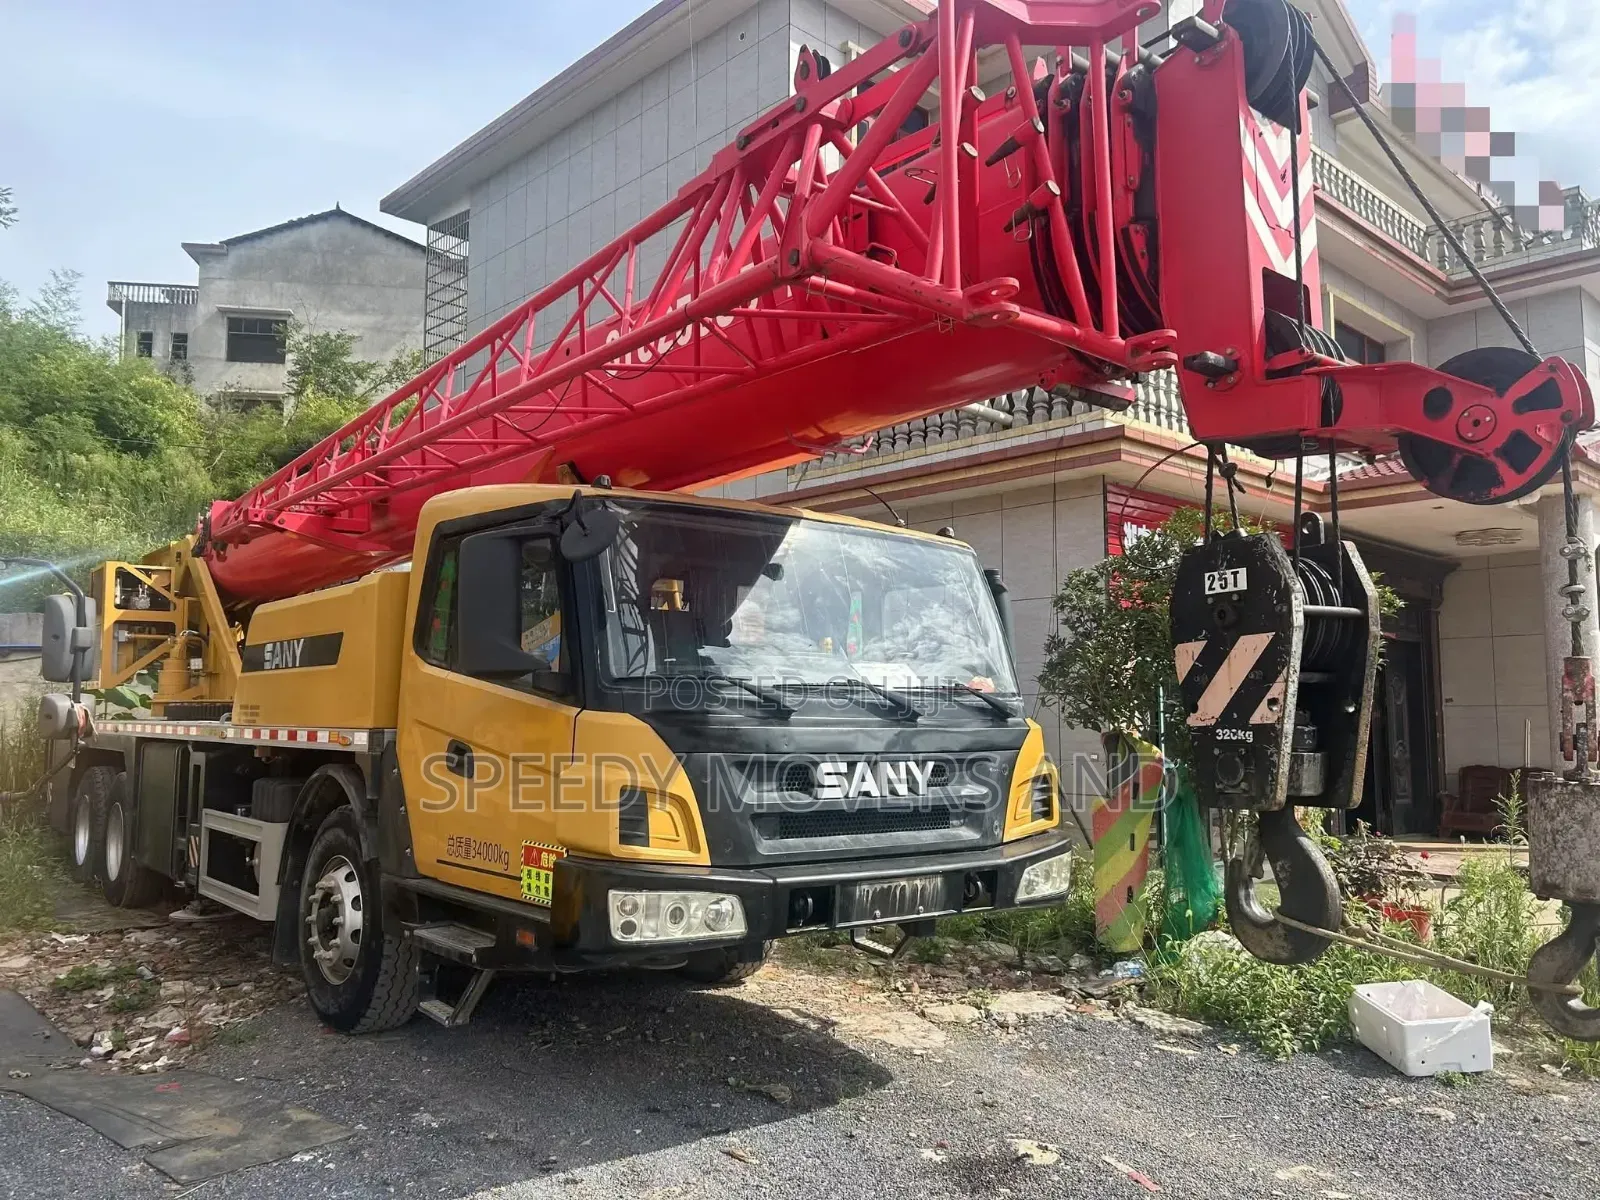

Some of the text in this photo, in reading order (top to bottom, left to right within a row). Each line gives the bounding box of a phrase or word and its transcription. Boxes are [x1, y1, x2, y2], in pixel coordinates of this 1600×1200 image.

[1207, 570, 1240, 592] 25T
[263, 638, 304, 670] SANY
[1215, 728, 1254, 744] 320kg
[816, 760, 935, 799] SANY
[446, 834, 510, 871] 总质量34000kg
